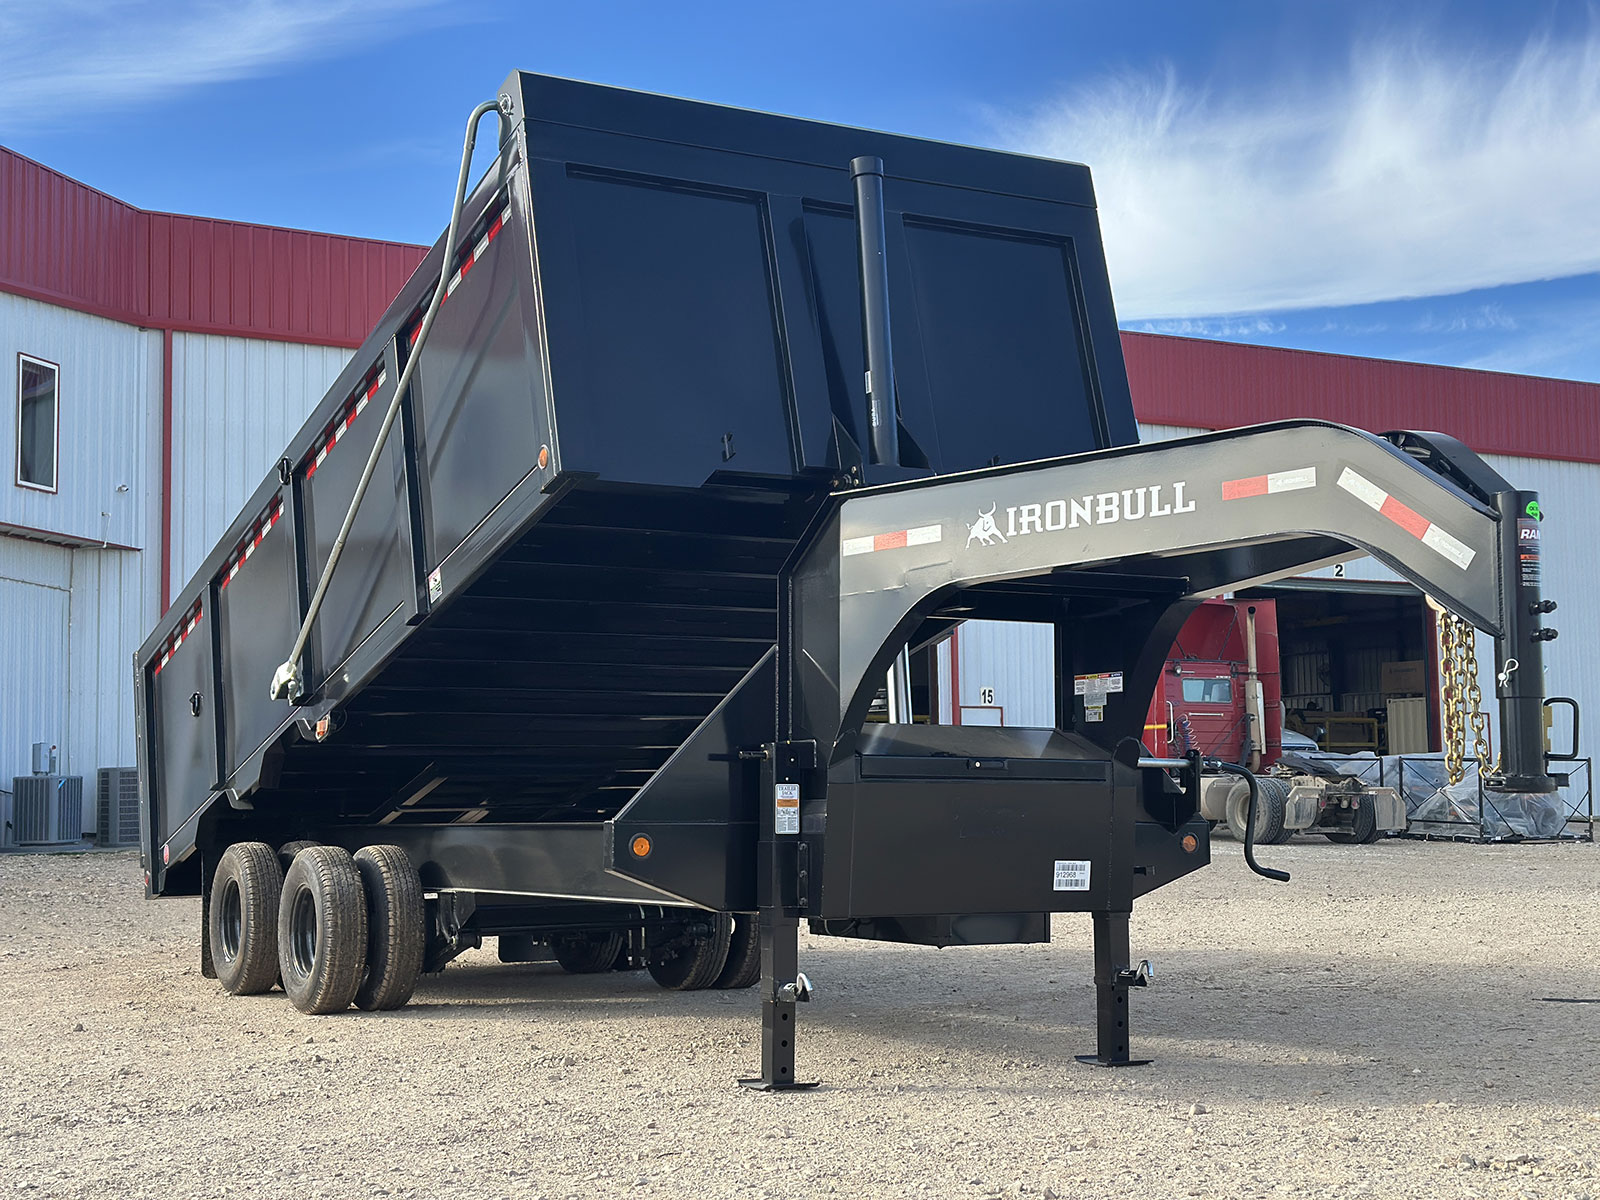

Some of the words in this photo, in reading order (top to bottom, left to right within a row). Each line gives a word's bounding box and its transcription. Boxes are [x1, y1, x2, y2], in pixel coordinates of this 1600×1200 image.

[1006, 481, 1196, 537] IRONBULL
[1335, 564, 1343, 577] 2
[982, 689, 993, 704] 15
